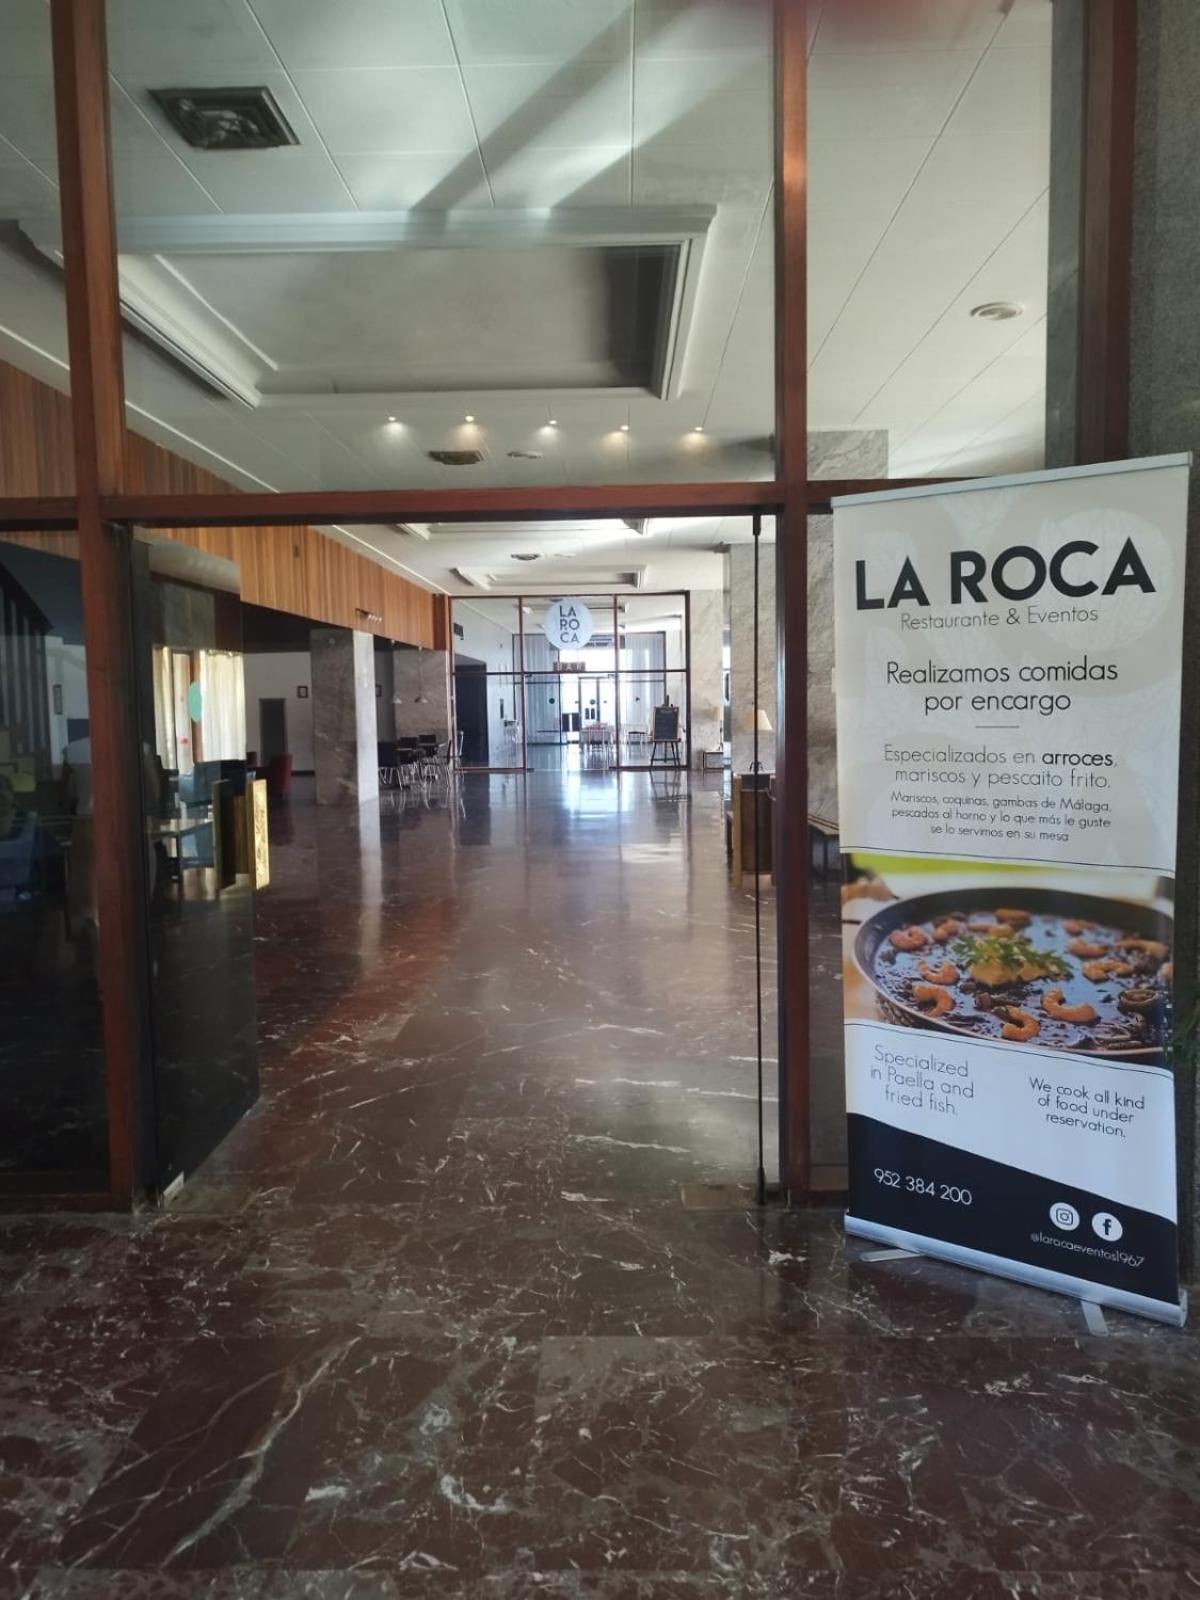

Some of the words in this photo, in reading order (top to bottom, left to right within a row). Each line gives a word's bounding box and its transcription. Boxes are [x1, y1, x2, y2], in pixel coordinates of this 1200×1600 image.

[855, 555, 931, 611] LA
[950, 536, 1157, 605] ROCA
[558, 605, 577, 617] LA
[900, 612, 1000, 630] Restaurante
[1006, 607, 1020, 625] &
[1026, 605, 1098, 625] Eventos
[558, 618, 581, 631] RO
[559, 631, 580, 643] CA
[887, 660, 1010, 684] Realizamos
[1018, 655, 1118, 682] comidas
[924, 694, 963, 716] por
[971, 692, 1072, 716] encargo
[884, 744, 1007, 765] Especializados
[1012, 750, 1036, 764] en
[1042, 750, 1118, 768] arroces,
[895, 769, 966, 784] mariscos
[972, 772, 981, 787] y
[988, 771, 1063, 788] pescaito
[1071, 768, 1111, 788] frito.
[992, 798, 1038, 809] gambas
[1041, 798, 1056, 809] de
[892, 807, 940, 821] pescados
[942, 809, 953, 820] al
[955, 810, 987, 822] horno
[990, 814, 997, 823] y
[1001, 812, 1010, 823] lo
[1013, 814, 1036, 827] que
[1039, 814, 1061, 826] más
[1065, 813, 1075, 827] le
[1078, 817, 1111, 830] guste
[931, 824, 942, 834] se
[945, 823, 955, 835] lo
[958, 826, 1004, 838] servimos
[1006, 828, 1021, 839] en
[1023, 830, 1036, 840] su
[1039, 830, 1069, 842] mesa
[874, 1044, 969, 1078] Specialized
[870, 1065, 882, 1081] in
[887, 1065, 935, 1090] Paella
[940, 1080, 974, 1099] and
[1029, 1076, 1052, 1093] We
[1056, 1084, 1090, 1101] cook
[1094, 1089, 1110, 1104] all
[1114, 1090, 1146, 1110] kind
[885, 1084, 923, 1108] fried
[929, 1092, 958, 1117] fish.
[1037, 1094, 1051, 1107] of
[1056, 1095, 1088, 1115] food
[1092, 1107, 1136, 1123] under
[1045, 1112, 1127, 1138] reservation.
[873, 1168, 901, 1189] 952
[905, 1176, 936, 1197] 384
[939, 1185, 973, 1206] 200
